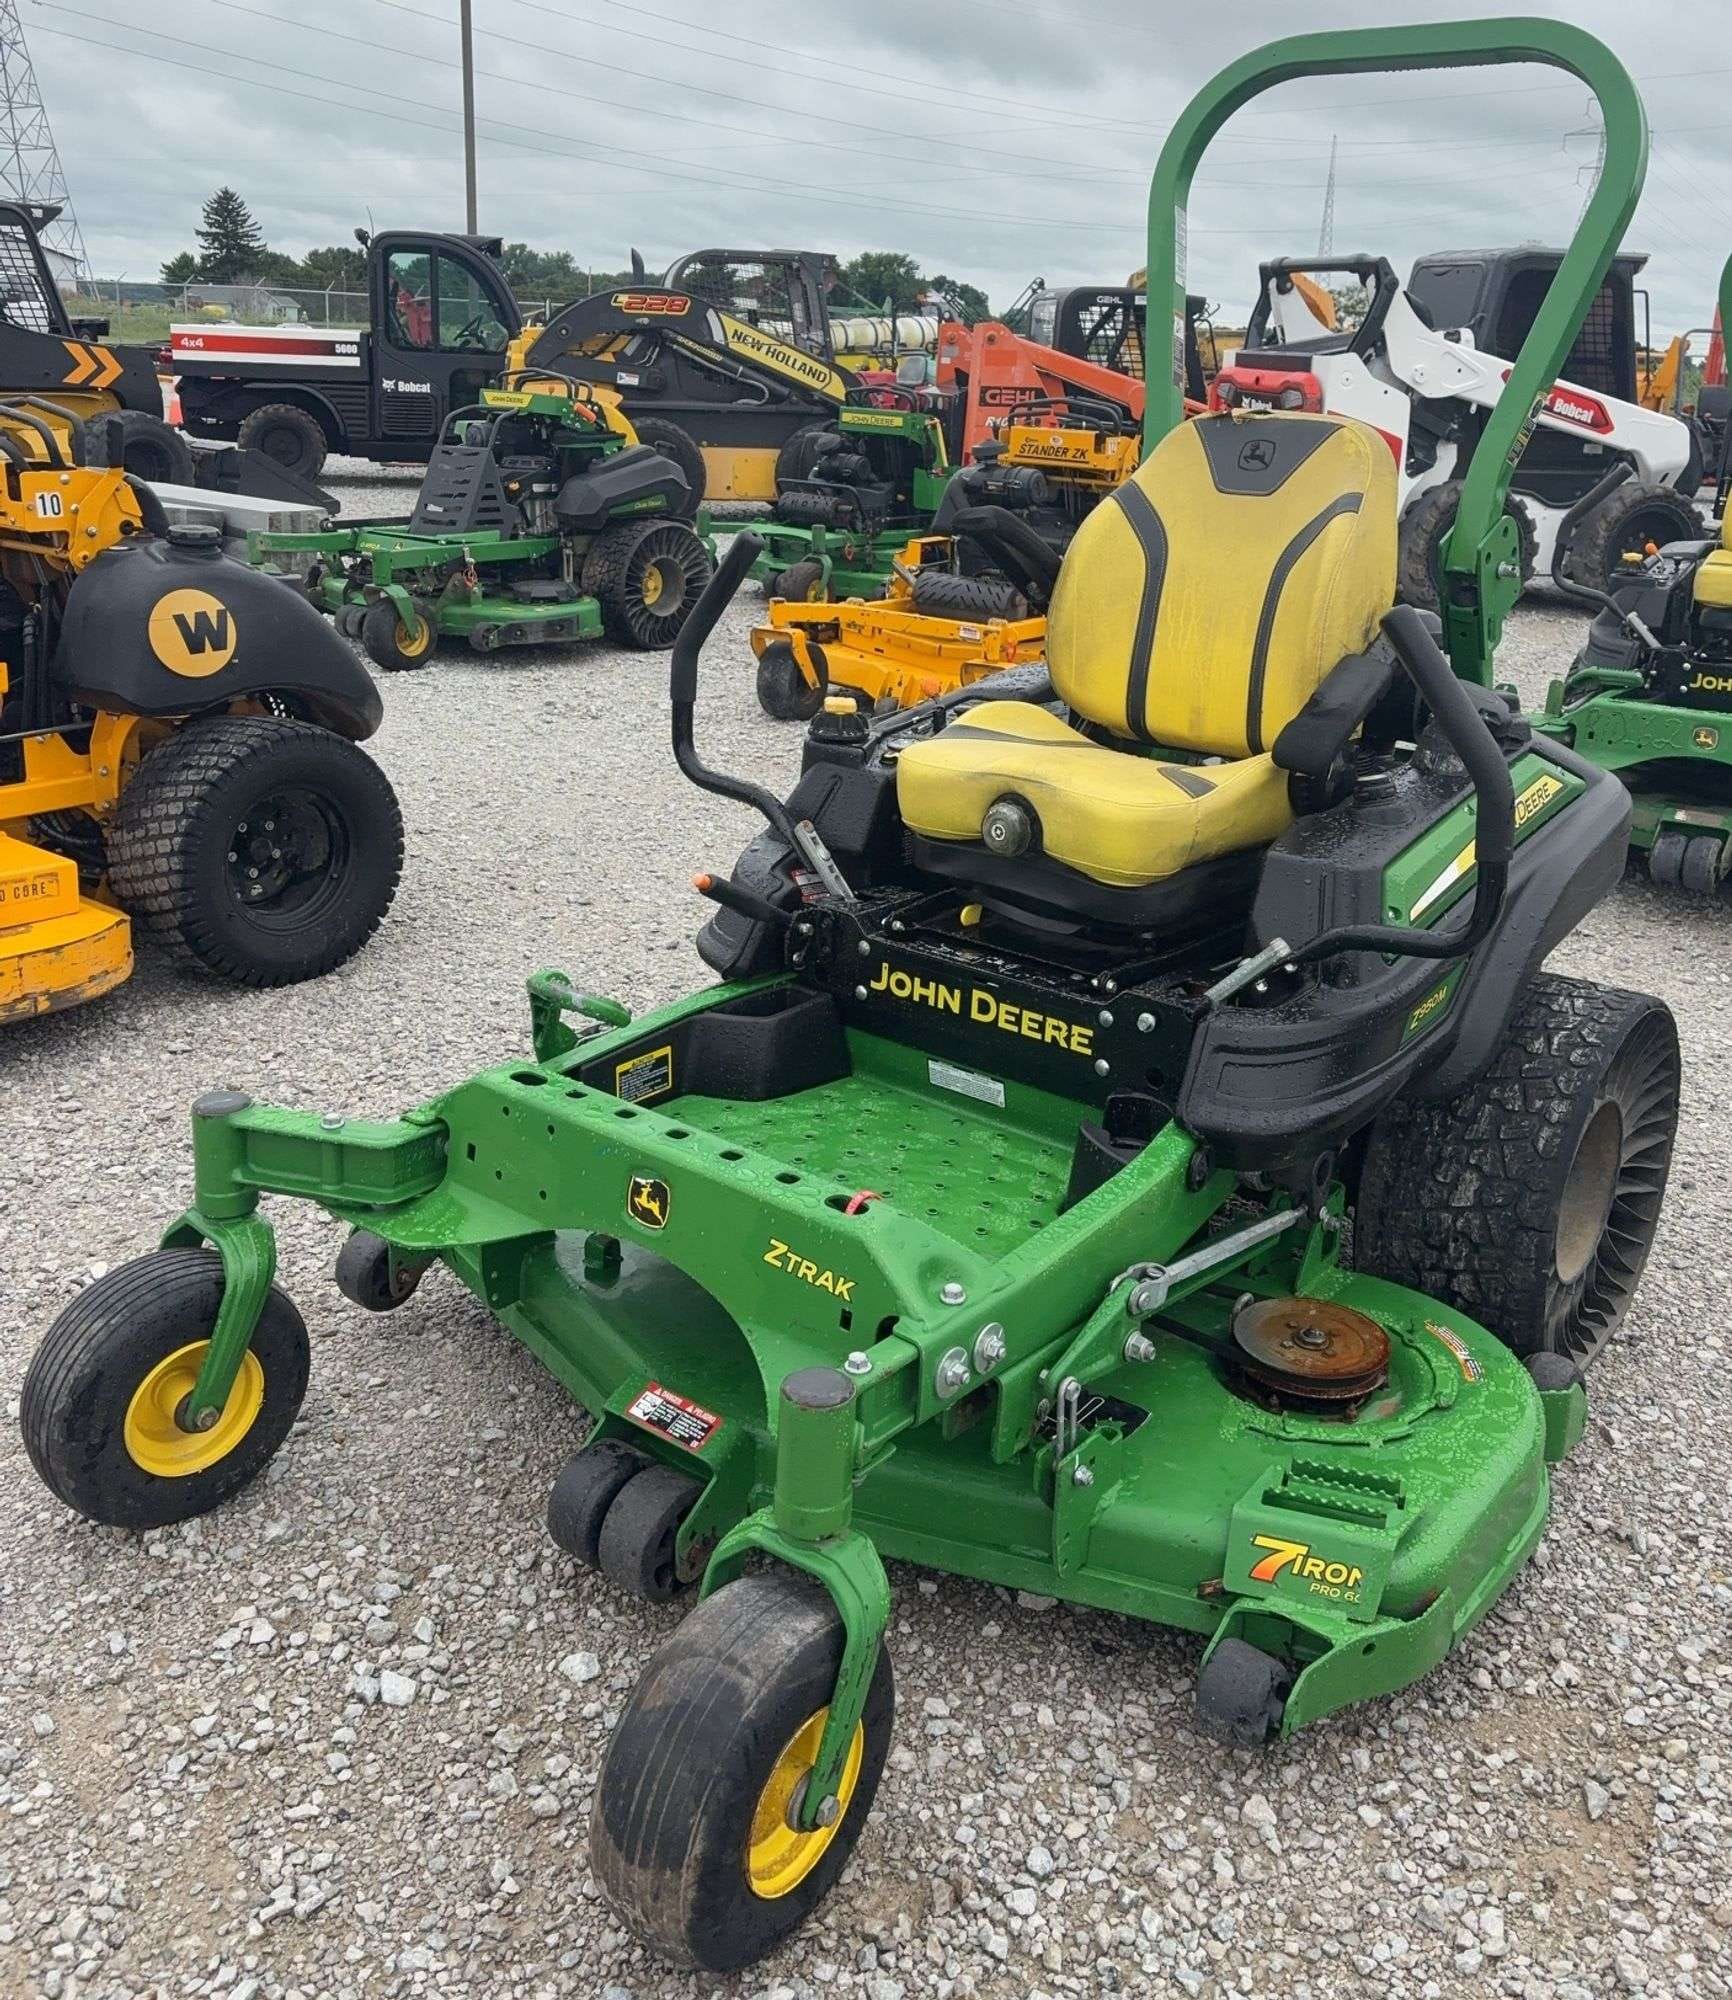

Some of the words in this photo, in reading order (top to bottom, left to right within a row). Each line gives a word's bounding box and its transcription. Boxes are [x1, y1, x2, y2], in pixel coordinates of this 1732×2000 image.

[180, 337, 204, 349] 4x4
[731, 328, 764, 351] NEW
[764, 345, 827, 383] HOLLAND
[398, 381, 431, 393] Bobcat
[849, 414, 869, 424] JOHN
[870, 416, 896, 426] DEERE
[1552, 397, 1595, 424] Bobcat
[1019, 442, 1070, 458] STANDER
[1071, 448, 1089, 460] ZK
[38, 493, 61, 516] 10
[172, 608, 228, 655] W
[1517, 782, 1551, 821] DEERE
[13, 882, 46, 899] CORE
[870, 962, 961, 1015] JOHN
[970, 988, 1094, 1056] DEERE
[763, 1238, 857, 1303] ZTRAK
[1309, 1583, 1341, 1598] PRO
